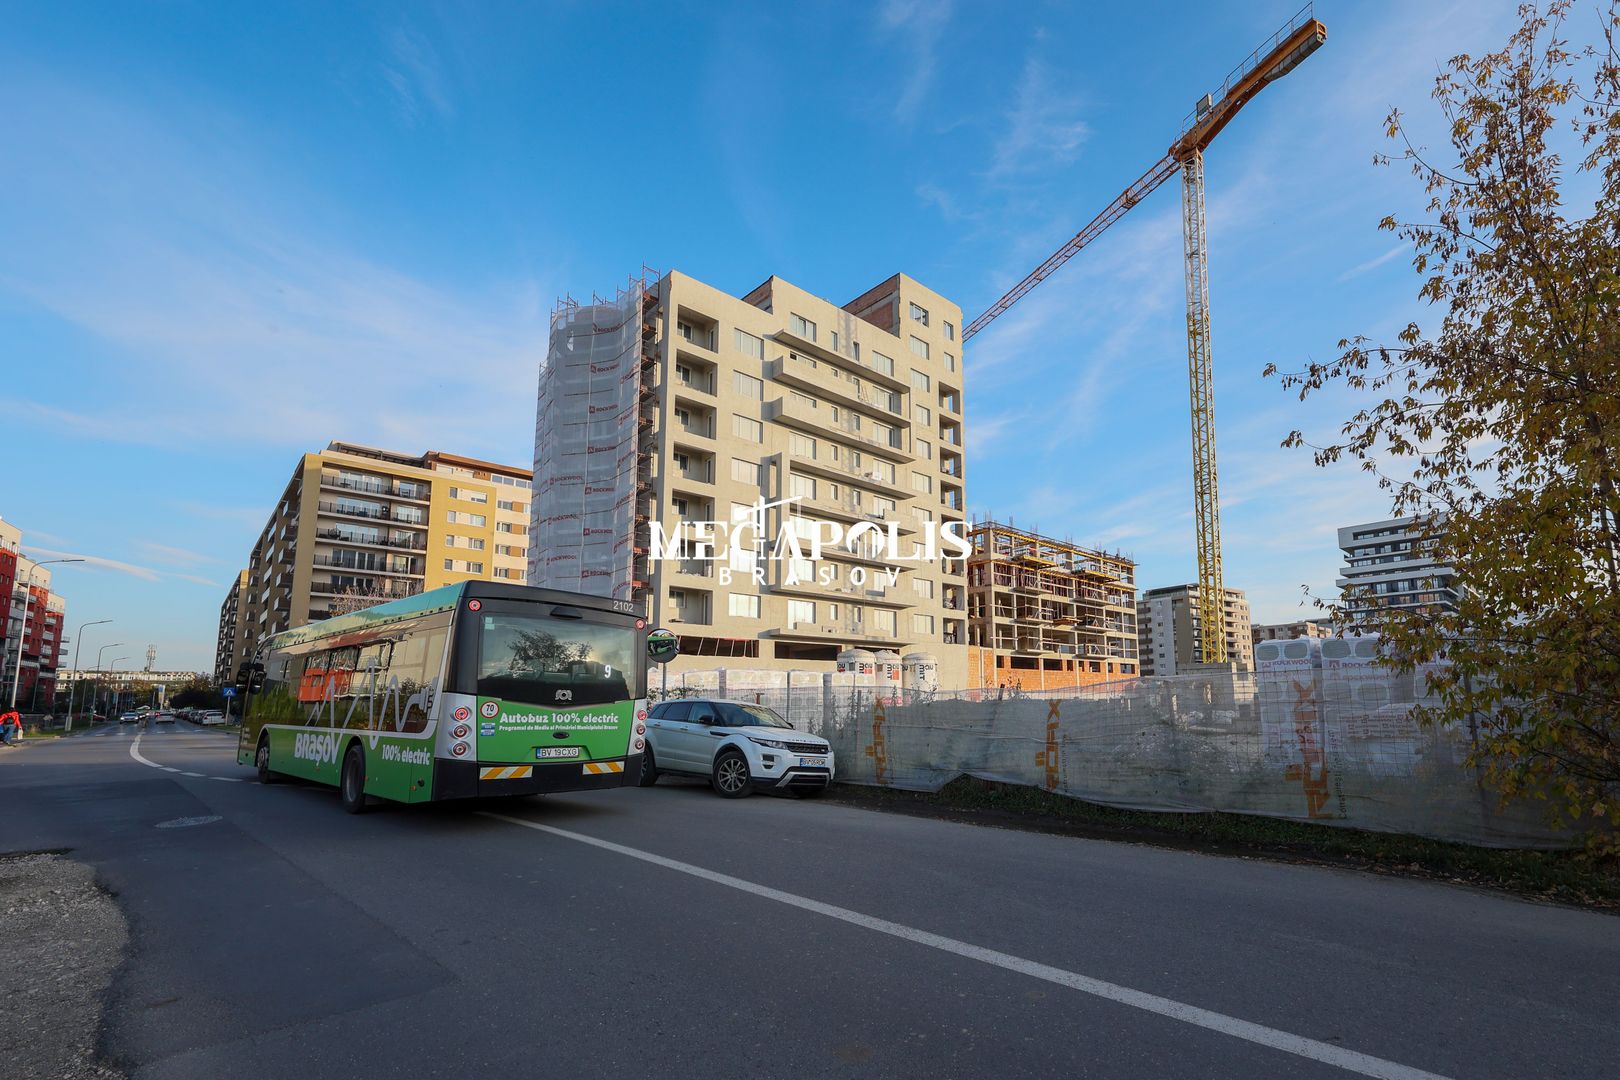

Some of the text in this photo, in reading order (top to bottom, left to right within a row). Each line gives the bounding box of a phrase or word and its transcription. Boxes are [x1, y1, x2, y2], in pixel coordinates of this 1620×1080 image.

[613, 600, 634, 613] 2102
[604, 664, 612, 678] 9
[486, 704, 495, 712] 70
[500, 712, 619, 723] Autobuz 100% electric
[382, 744, 431, 765] 100% electric
